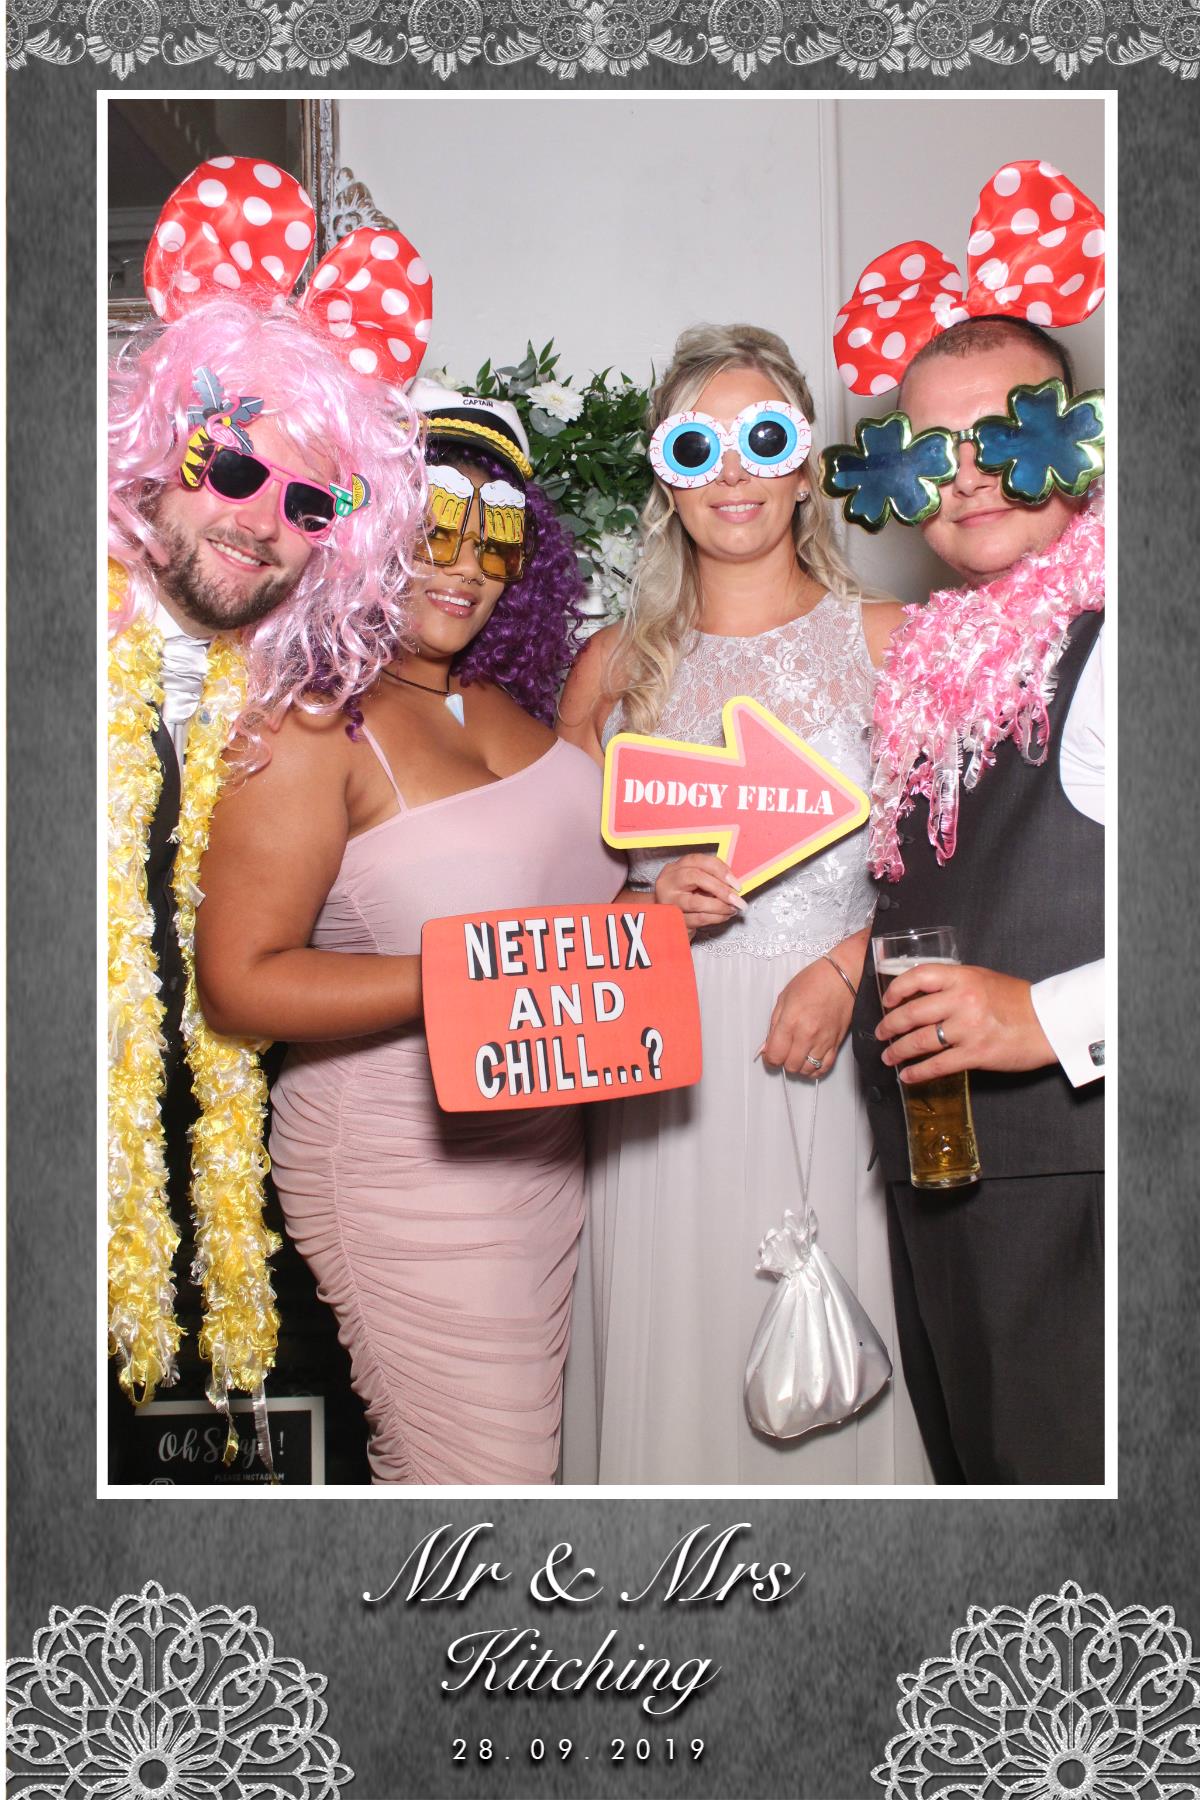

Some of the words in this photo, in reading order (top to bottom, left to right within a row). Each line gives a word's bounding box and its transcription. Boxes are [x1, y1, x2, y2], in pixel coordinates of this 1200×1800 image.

[463, 399, 494, 408] CAPTAIN
[624, 778, 728, 809] DODGY
[737, 785, 834, 816] FELLA
[464, 912, 652, 981] NETFLIX
[509, 981, 625, 1030] AND
[158, 1428, 200, 1462] Oh
